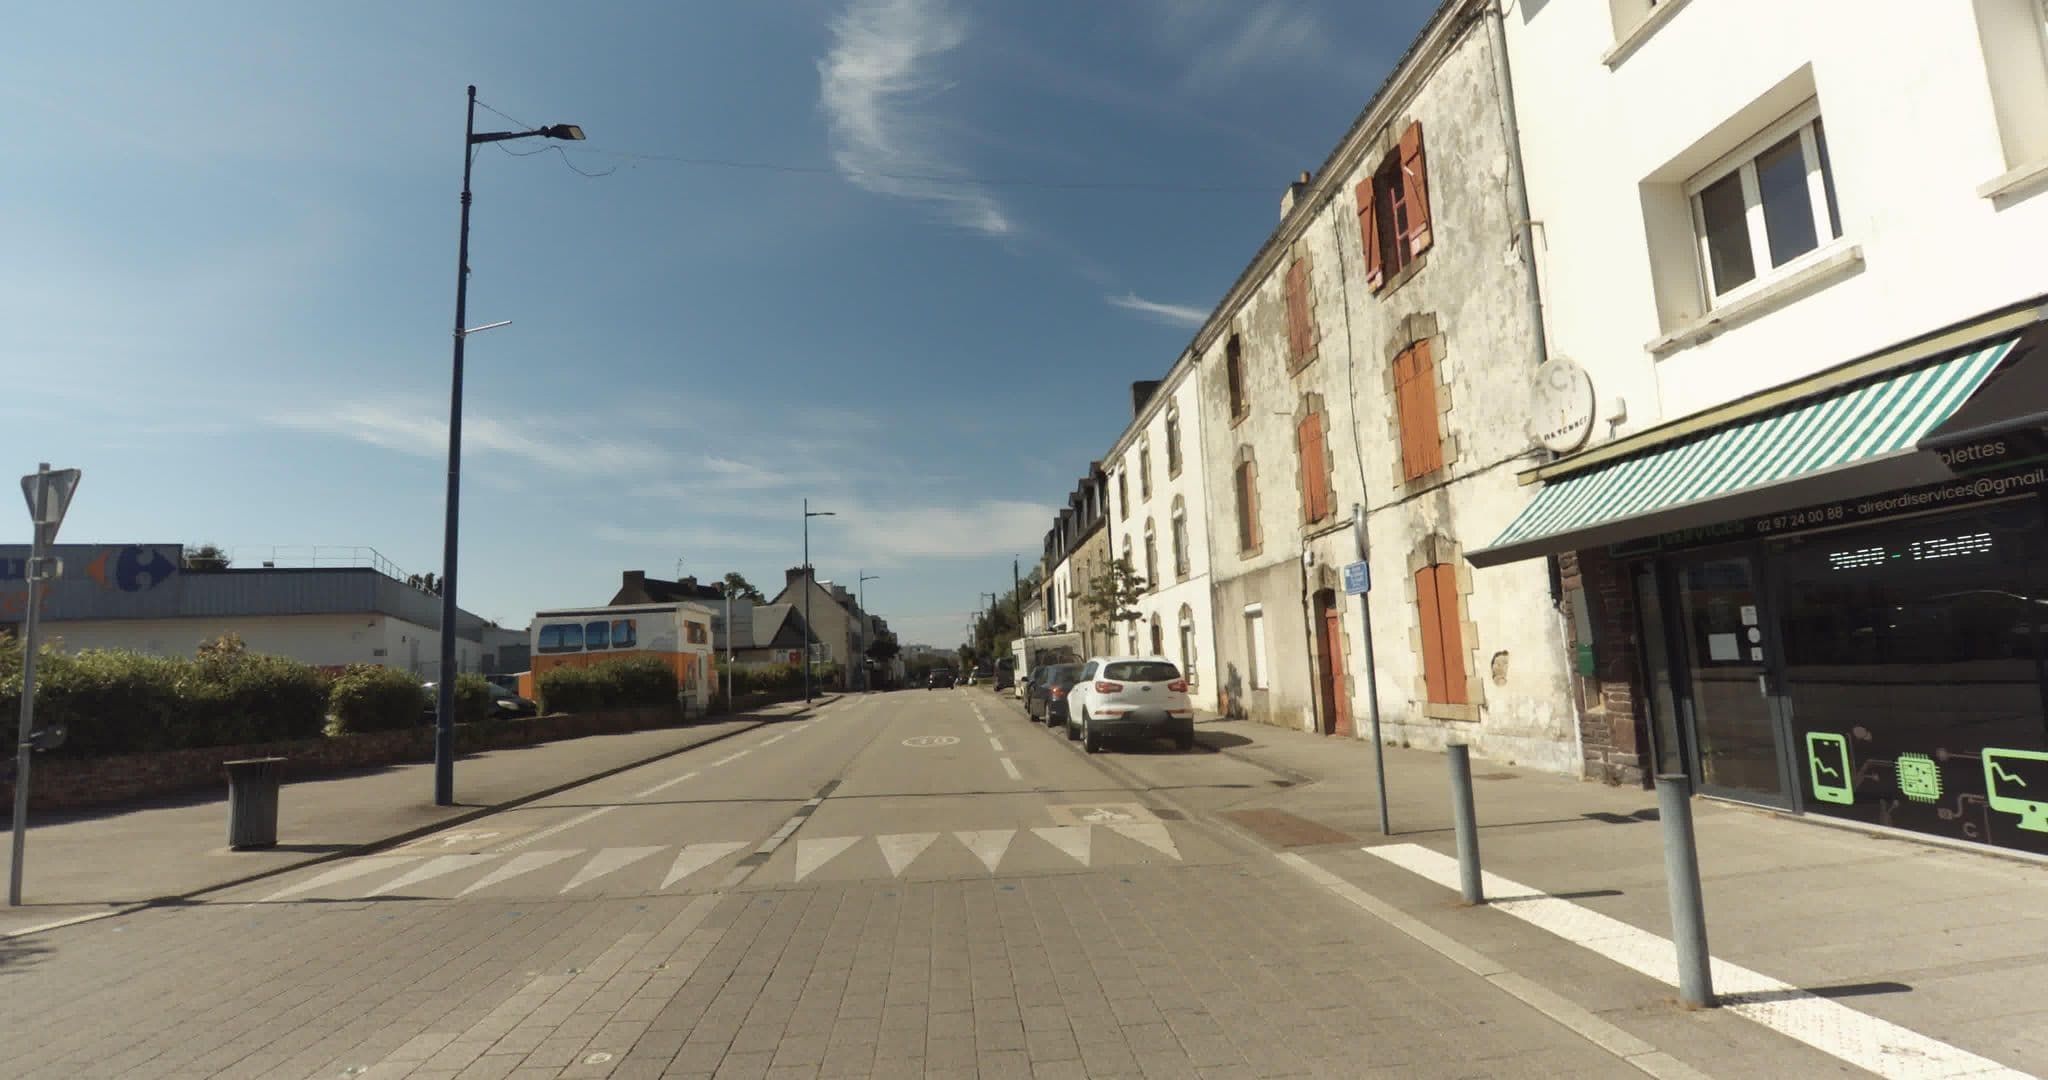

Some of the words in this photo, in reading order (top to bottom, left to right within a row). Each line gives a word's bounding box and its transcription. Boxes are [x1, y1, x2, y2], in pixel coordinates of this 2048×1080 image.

[1757, 519, 1771, 532] 02
[1775, 516, 1787, 529] 97
[1791, 513, 1805, 526] 24
[1808, 509, 1824, 523] 00
[1827, 505, 1844, 520] 88
